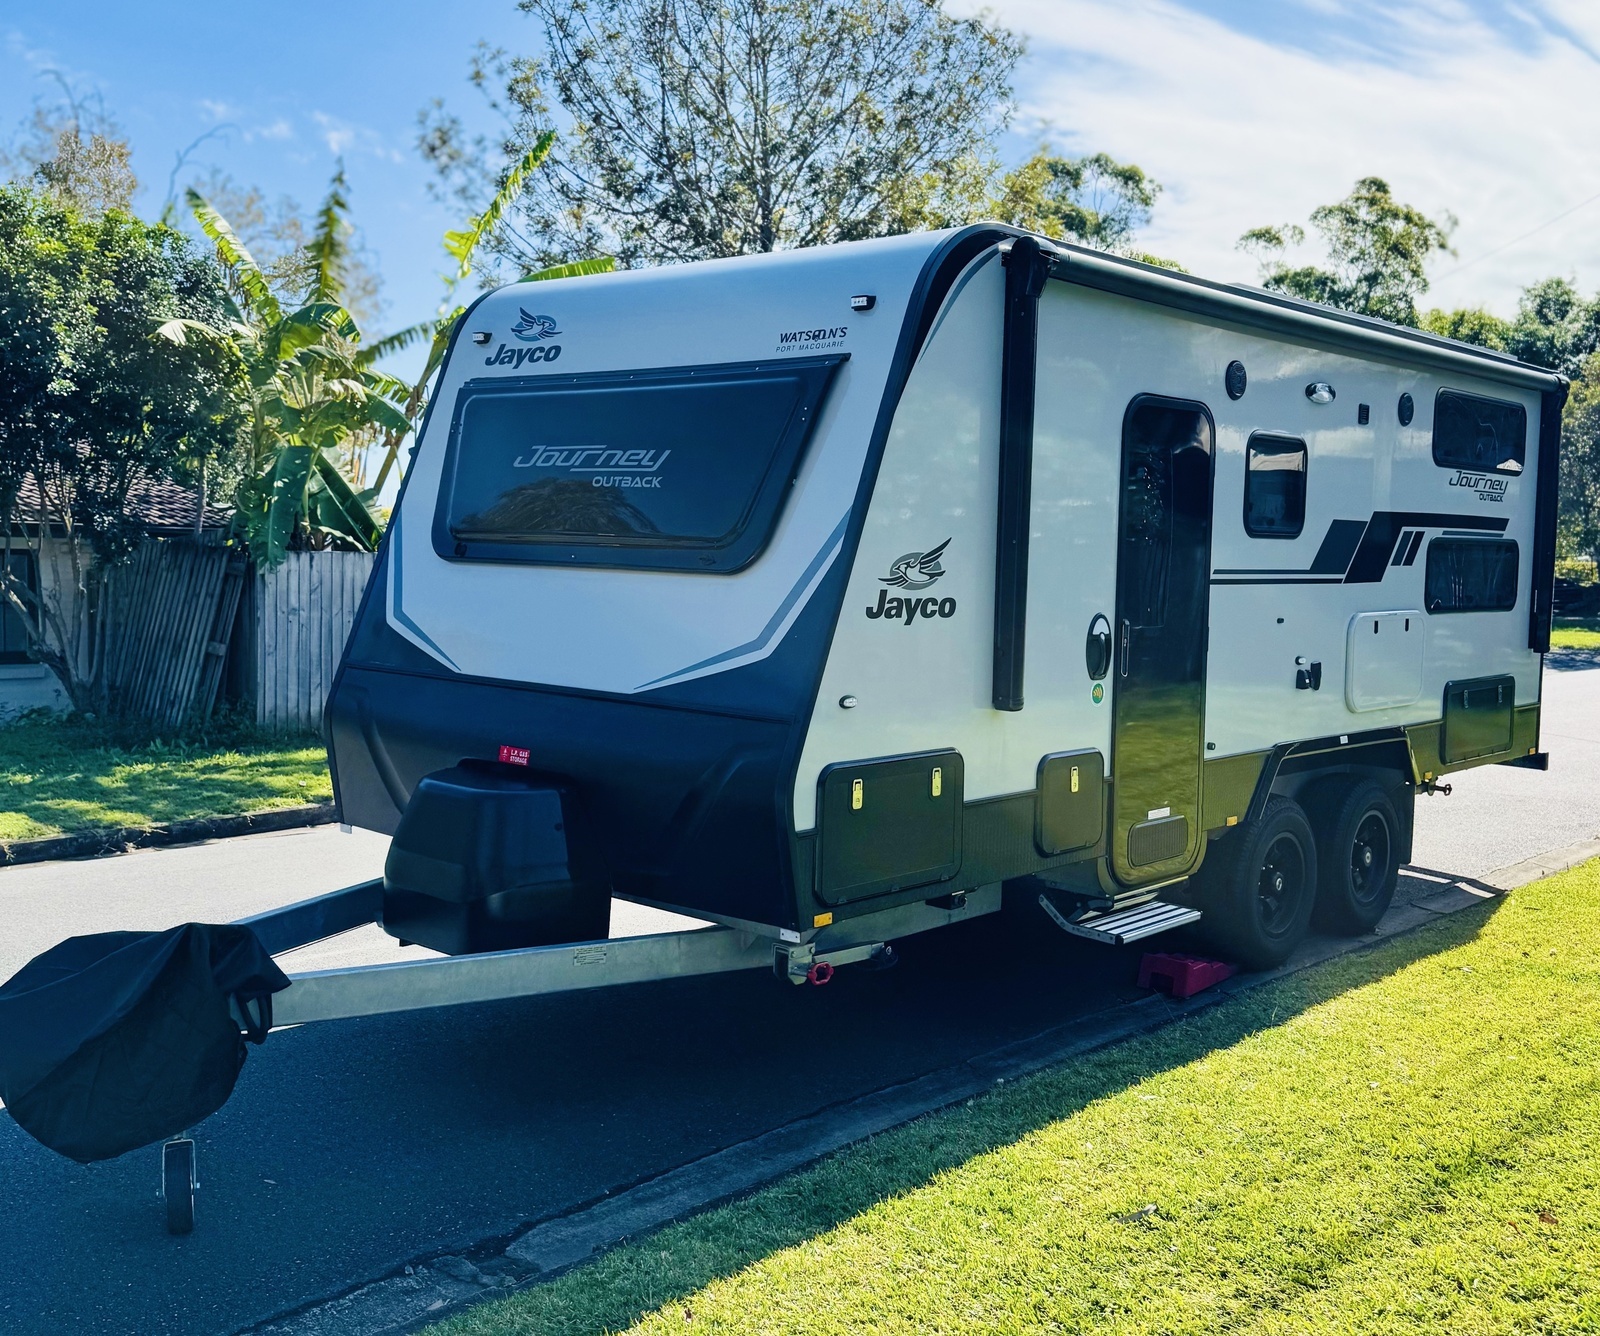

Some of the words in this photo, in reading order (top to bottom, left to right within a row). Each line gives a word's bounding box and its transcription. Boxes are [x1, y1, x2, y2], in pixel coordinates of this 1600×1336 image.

[485, 343, 562, 369] Jayco
[776, 344, 796, 353] PORT
[798, 340, 844, 351] MACQUARIE
[513, 444, 672, 472] Journey
[592, 476, 664, 488] OUTBACK
[1448, 470, 1509, 495] Journey
[1479, 493, 1504, 503] OUTBACK
[865, 589, 957, 626] Jayco
